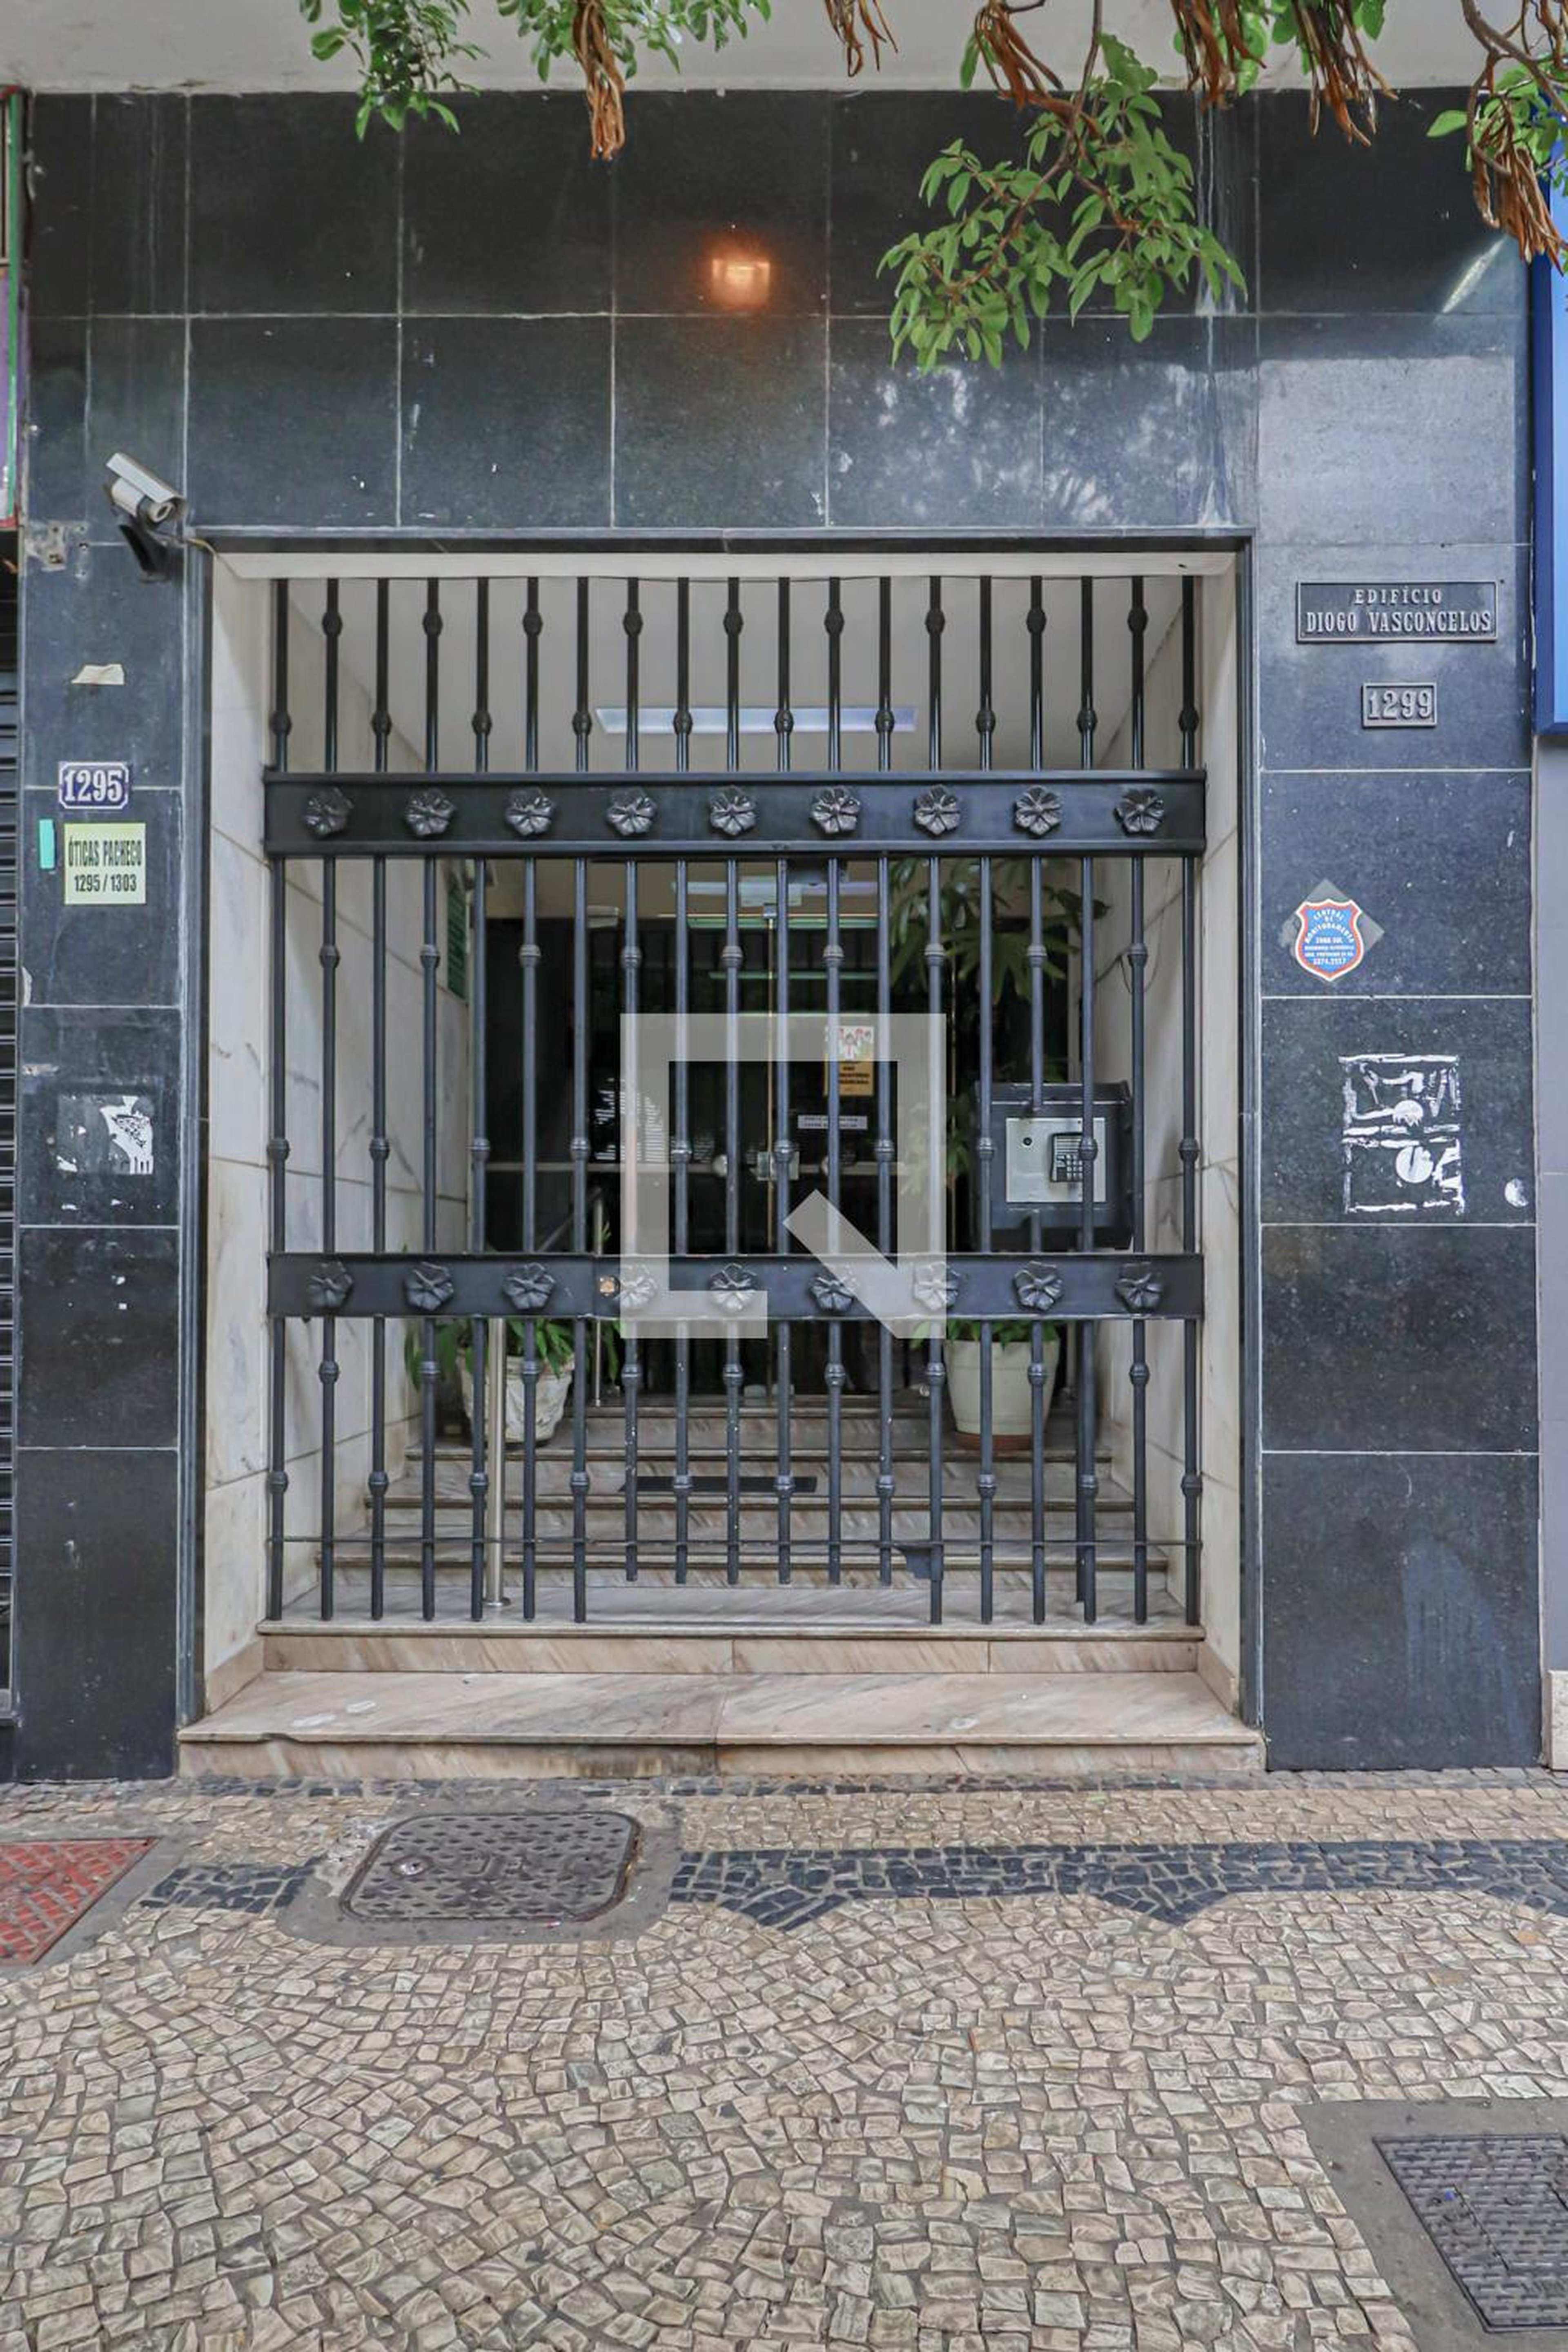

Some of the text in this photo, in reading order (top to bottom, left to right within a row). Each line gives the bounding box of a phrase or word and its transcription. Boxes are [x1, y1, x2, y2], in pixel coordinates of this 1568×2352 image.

[1307, 610, 1492, 633] DIOGO VASCONCELOS
[1368, 689, 1432, 720] 1299
[65, 770, 122, 802] 1295
[74, 874, 100, 892] 1295
[110, 874, 137, 892] 1303
